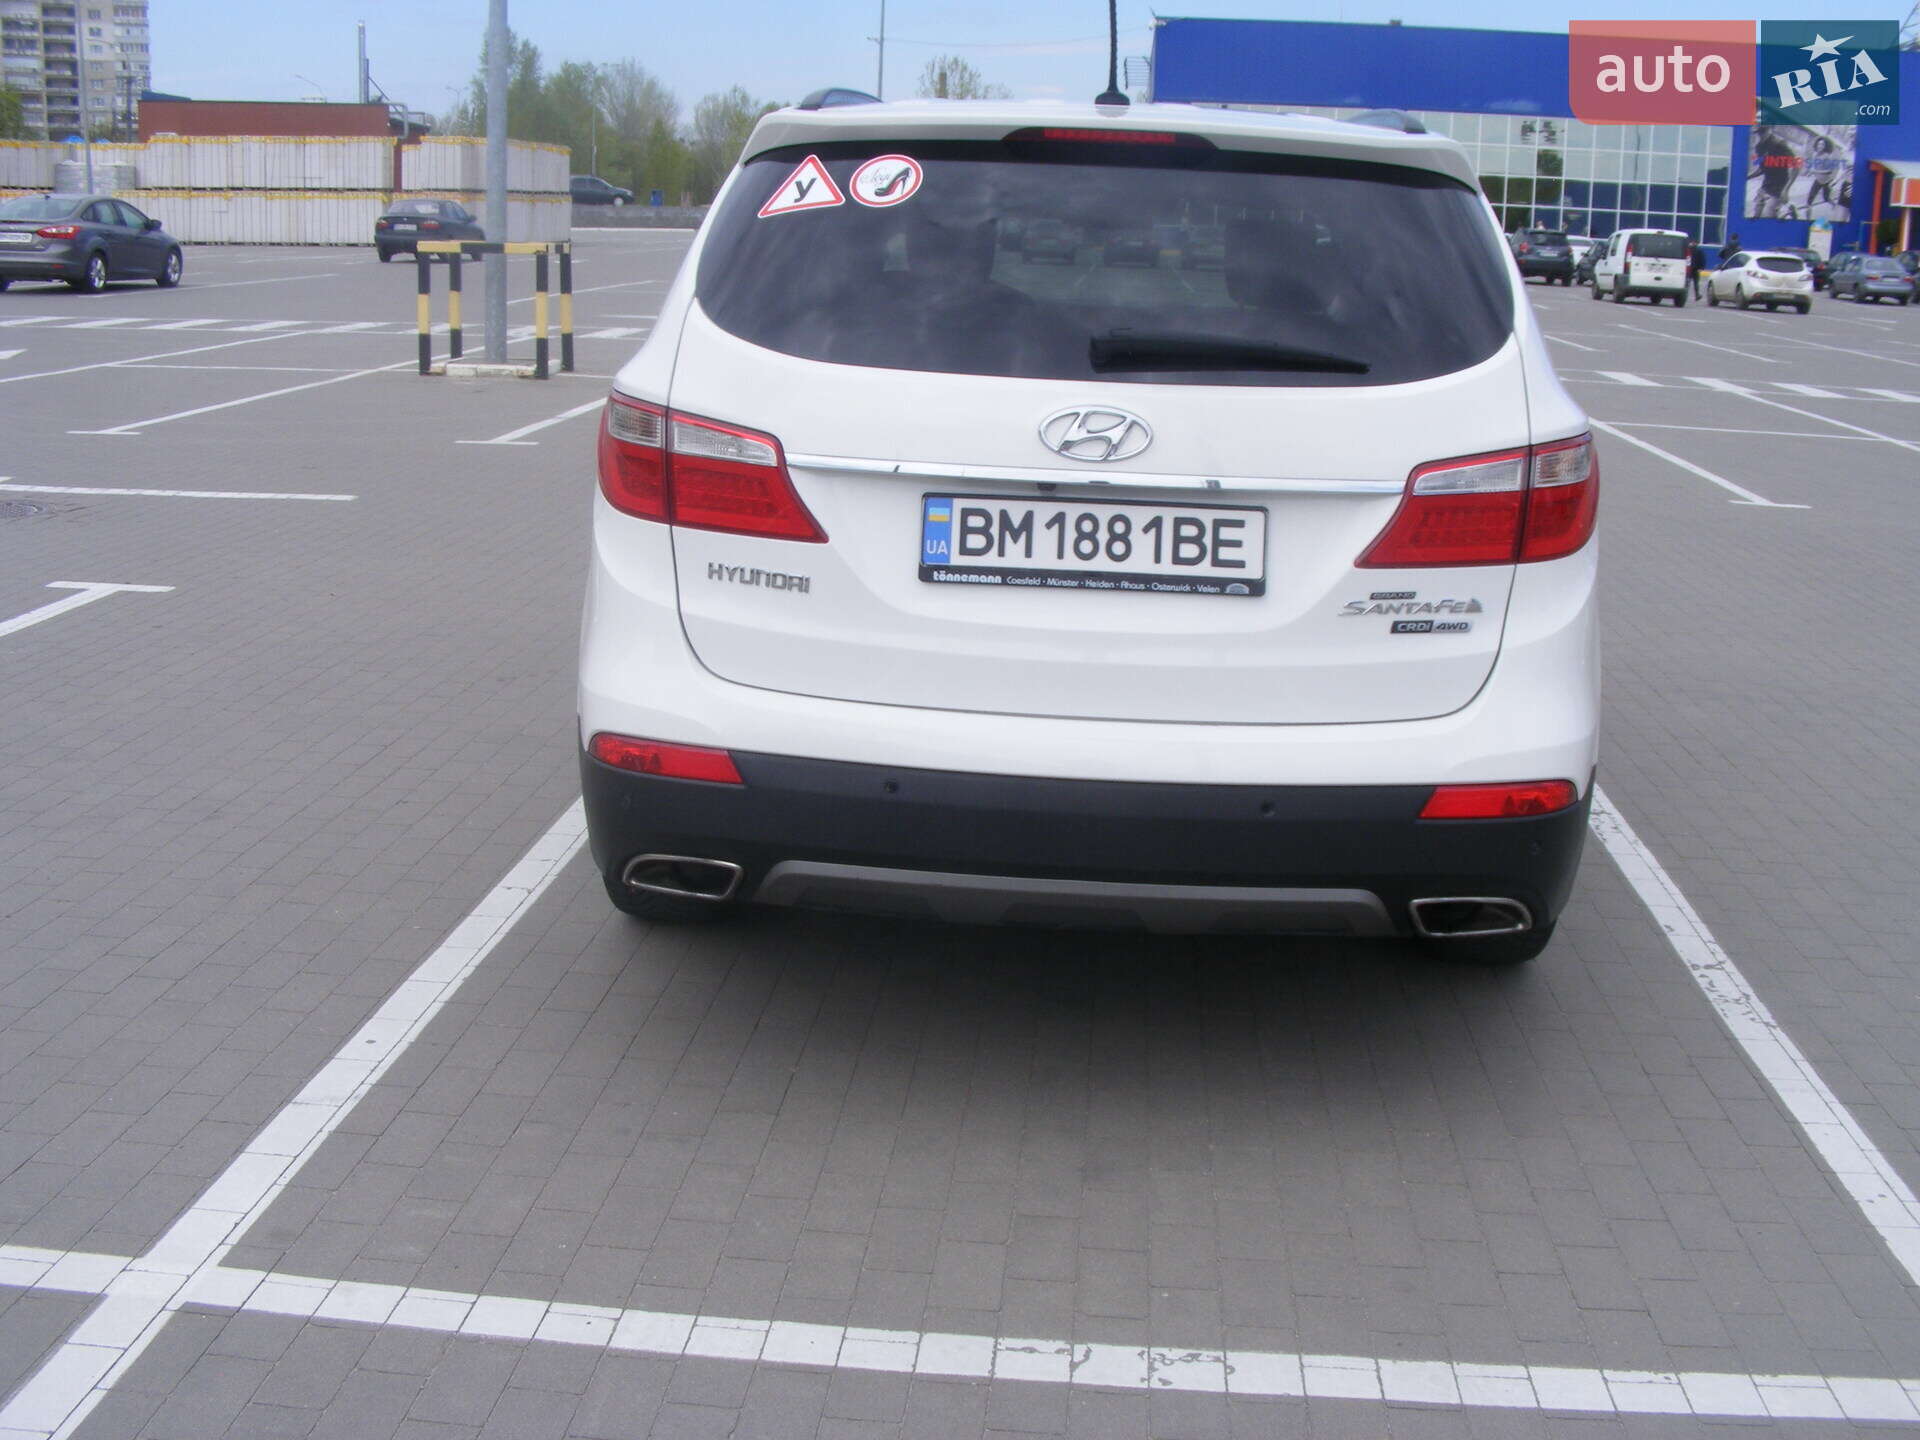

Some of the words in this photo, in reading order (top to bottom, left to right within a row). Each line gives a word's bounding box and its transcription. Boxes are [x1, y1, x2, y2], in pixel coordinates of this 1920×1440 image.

[926, 539, 949, 555] UA
[707, 562, 811, 594] HYUNDAI
[933, 570, 1002, 584] tönnemann
[1006, 575, 1041, 586] Coesfeld
[1047, 577, 1079, 588] Münster
[1085, 579, 1115, 589] Heiden
[1151, 582, 1192, 593] Osterwick
